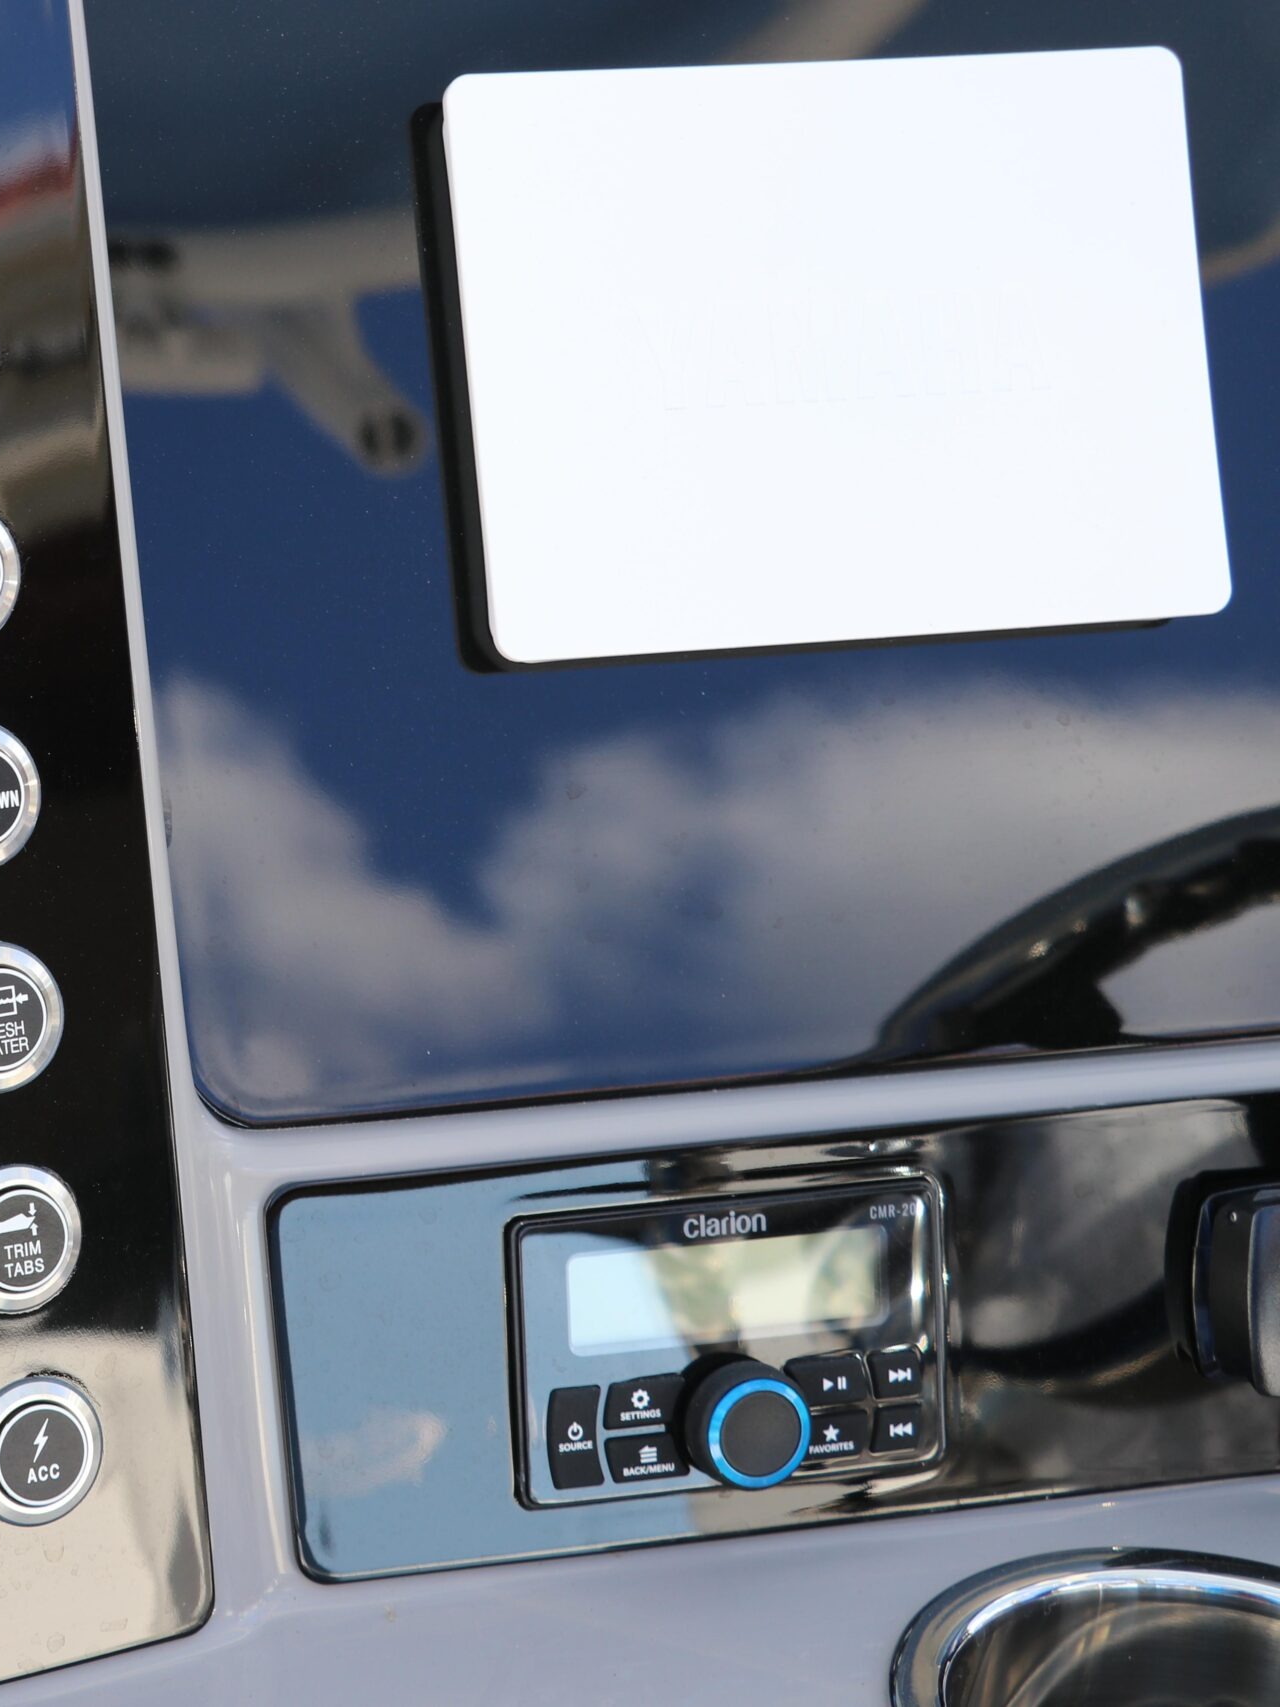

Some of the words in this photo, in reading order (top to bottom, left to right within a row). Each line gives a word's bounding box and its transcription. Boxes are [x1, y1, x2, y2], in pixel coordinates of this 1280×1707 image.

[625, 283, 1052, 411] YAMAHA
[683, 1211, 767, 1239] Clarion
[4, 1240, 41, 1260] TRIM
[4, 1258, 45, 1278] TABS
[620, 1408, 661, 1421] SETTINGS
[559, 1440, 593, 1452] SOURCE
[809, 1441, 854, 1454] FAVORITES
[27, 1463, 60, 1484] ACC
[623, 1463, 675, 1477] BACK/MENU
